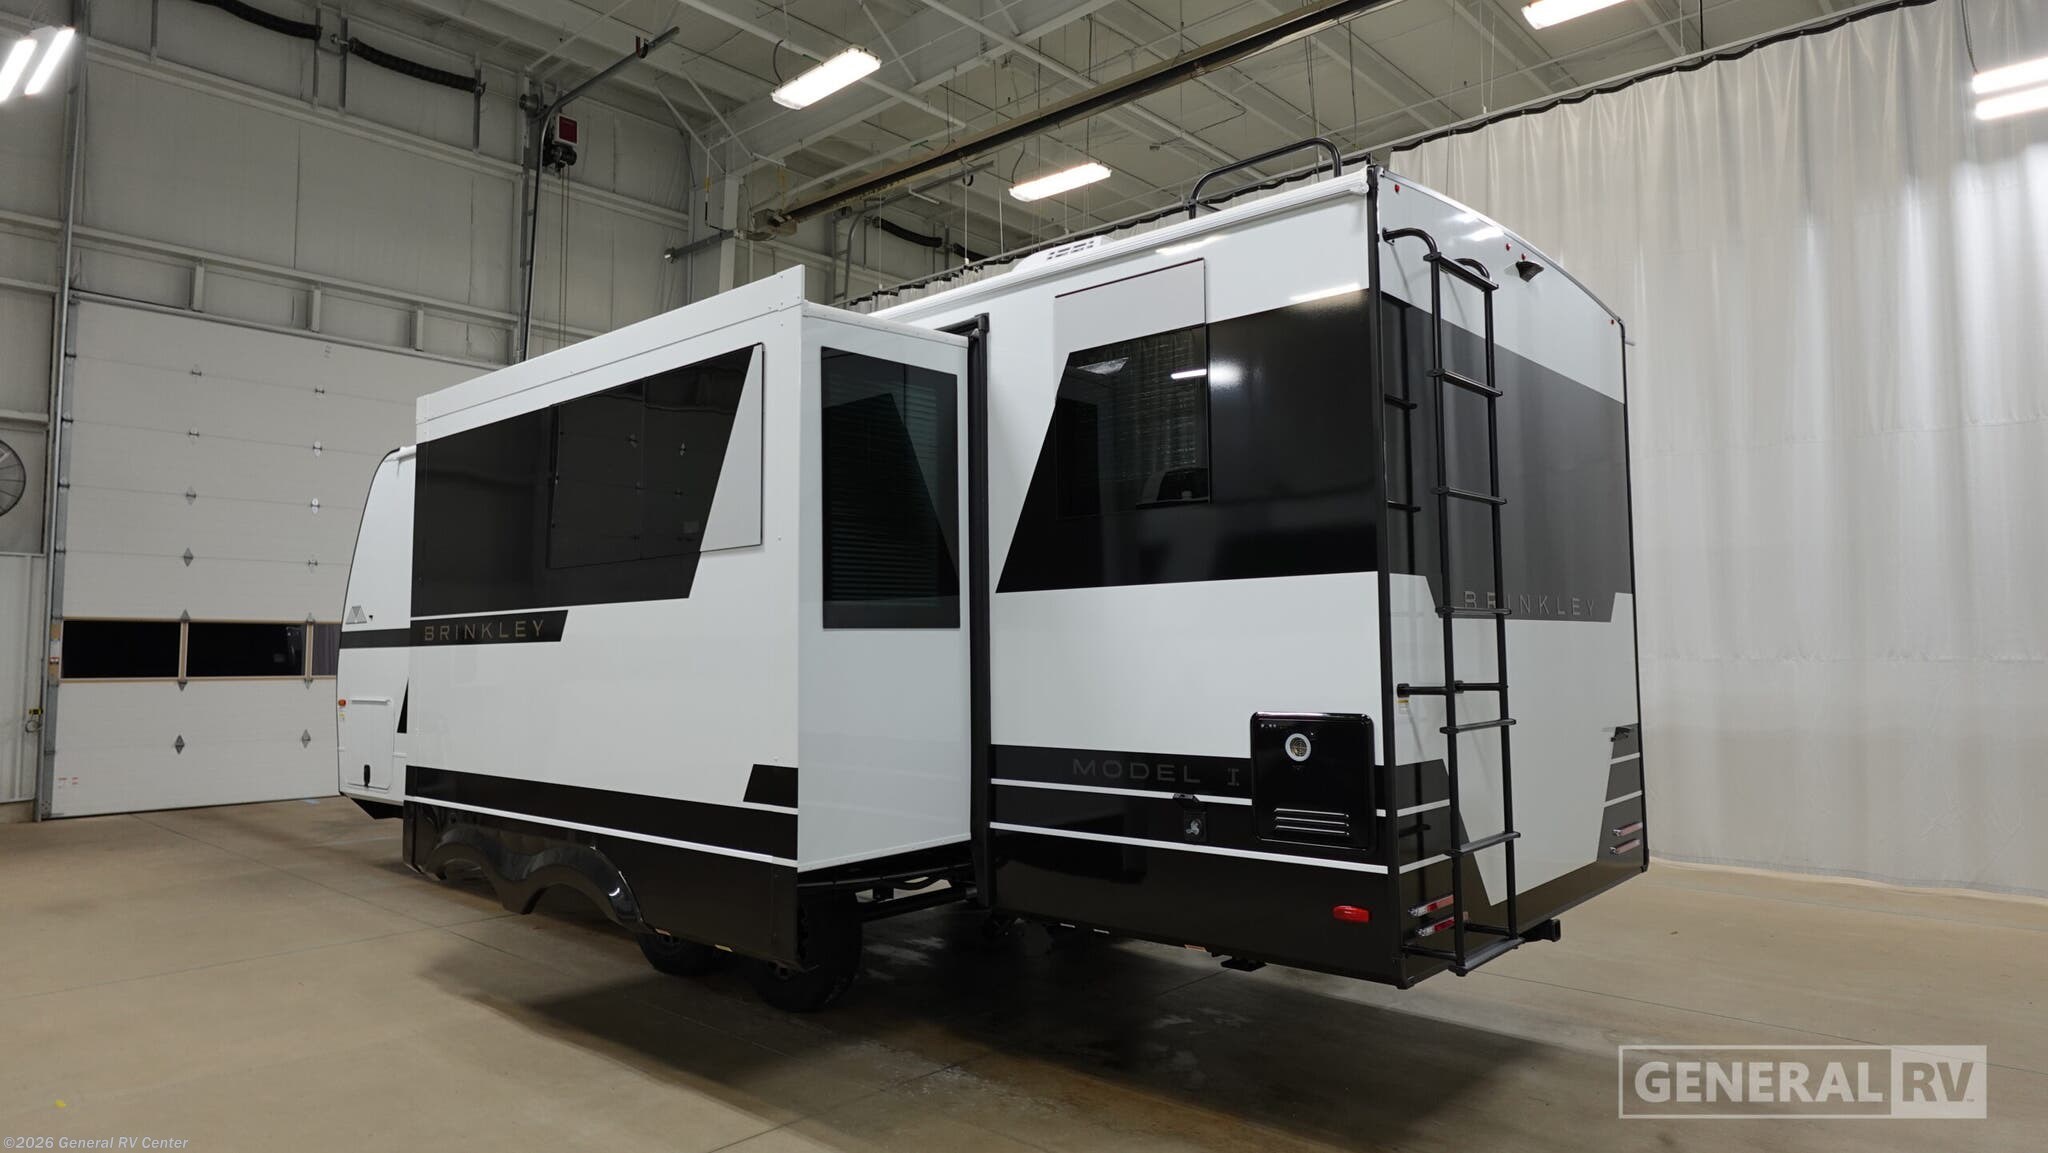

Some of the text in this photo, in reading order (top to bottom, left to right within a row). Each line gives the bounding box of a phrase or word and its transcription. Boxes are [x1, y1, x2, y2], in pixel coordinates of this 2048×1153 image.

[424, 619, 544, 641] BRINKLEY
[1072, 758, 1240, 786] MODEL I
